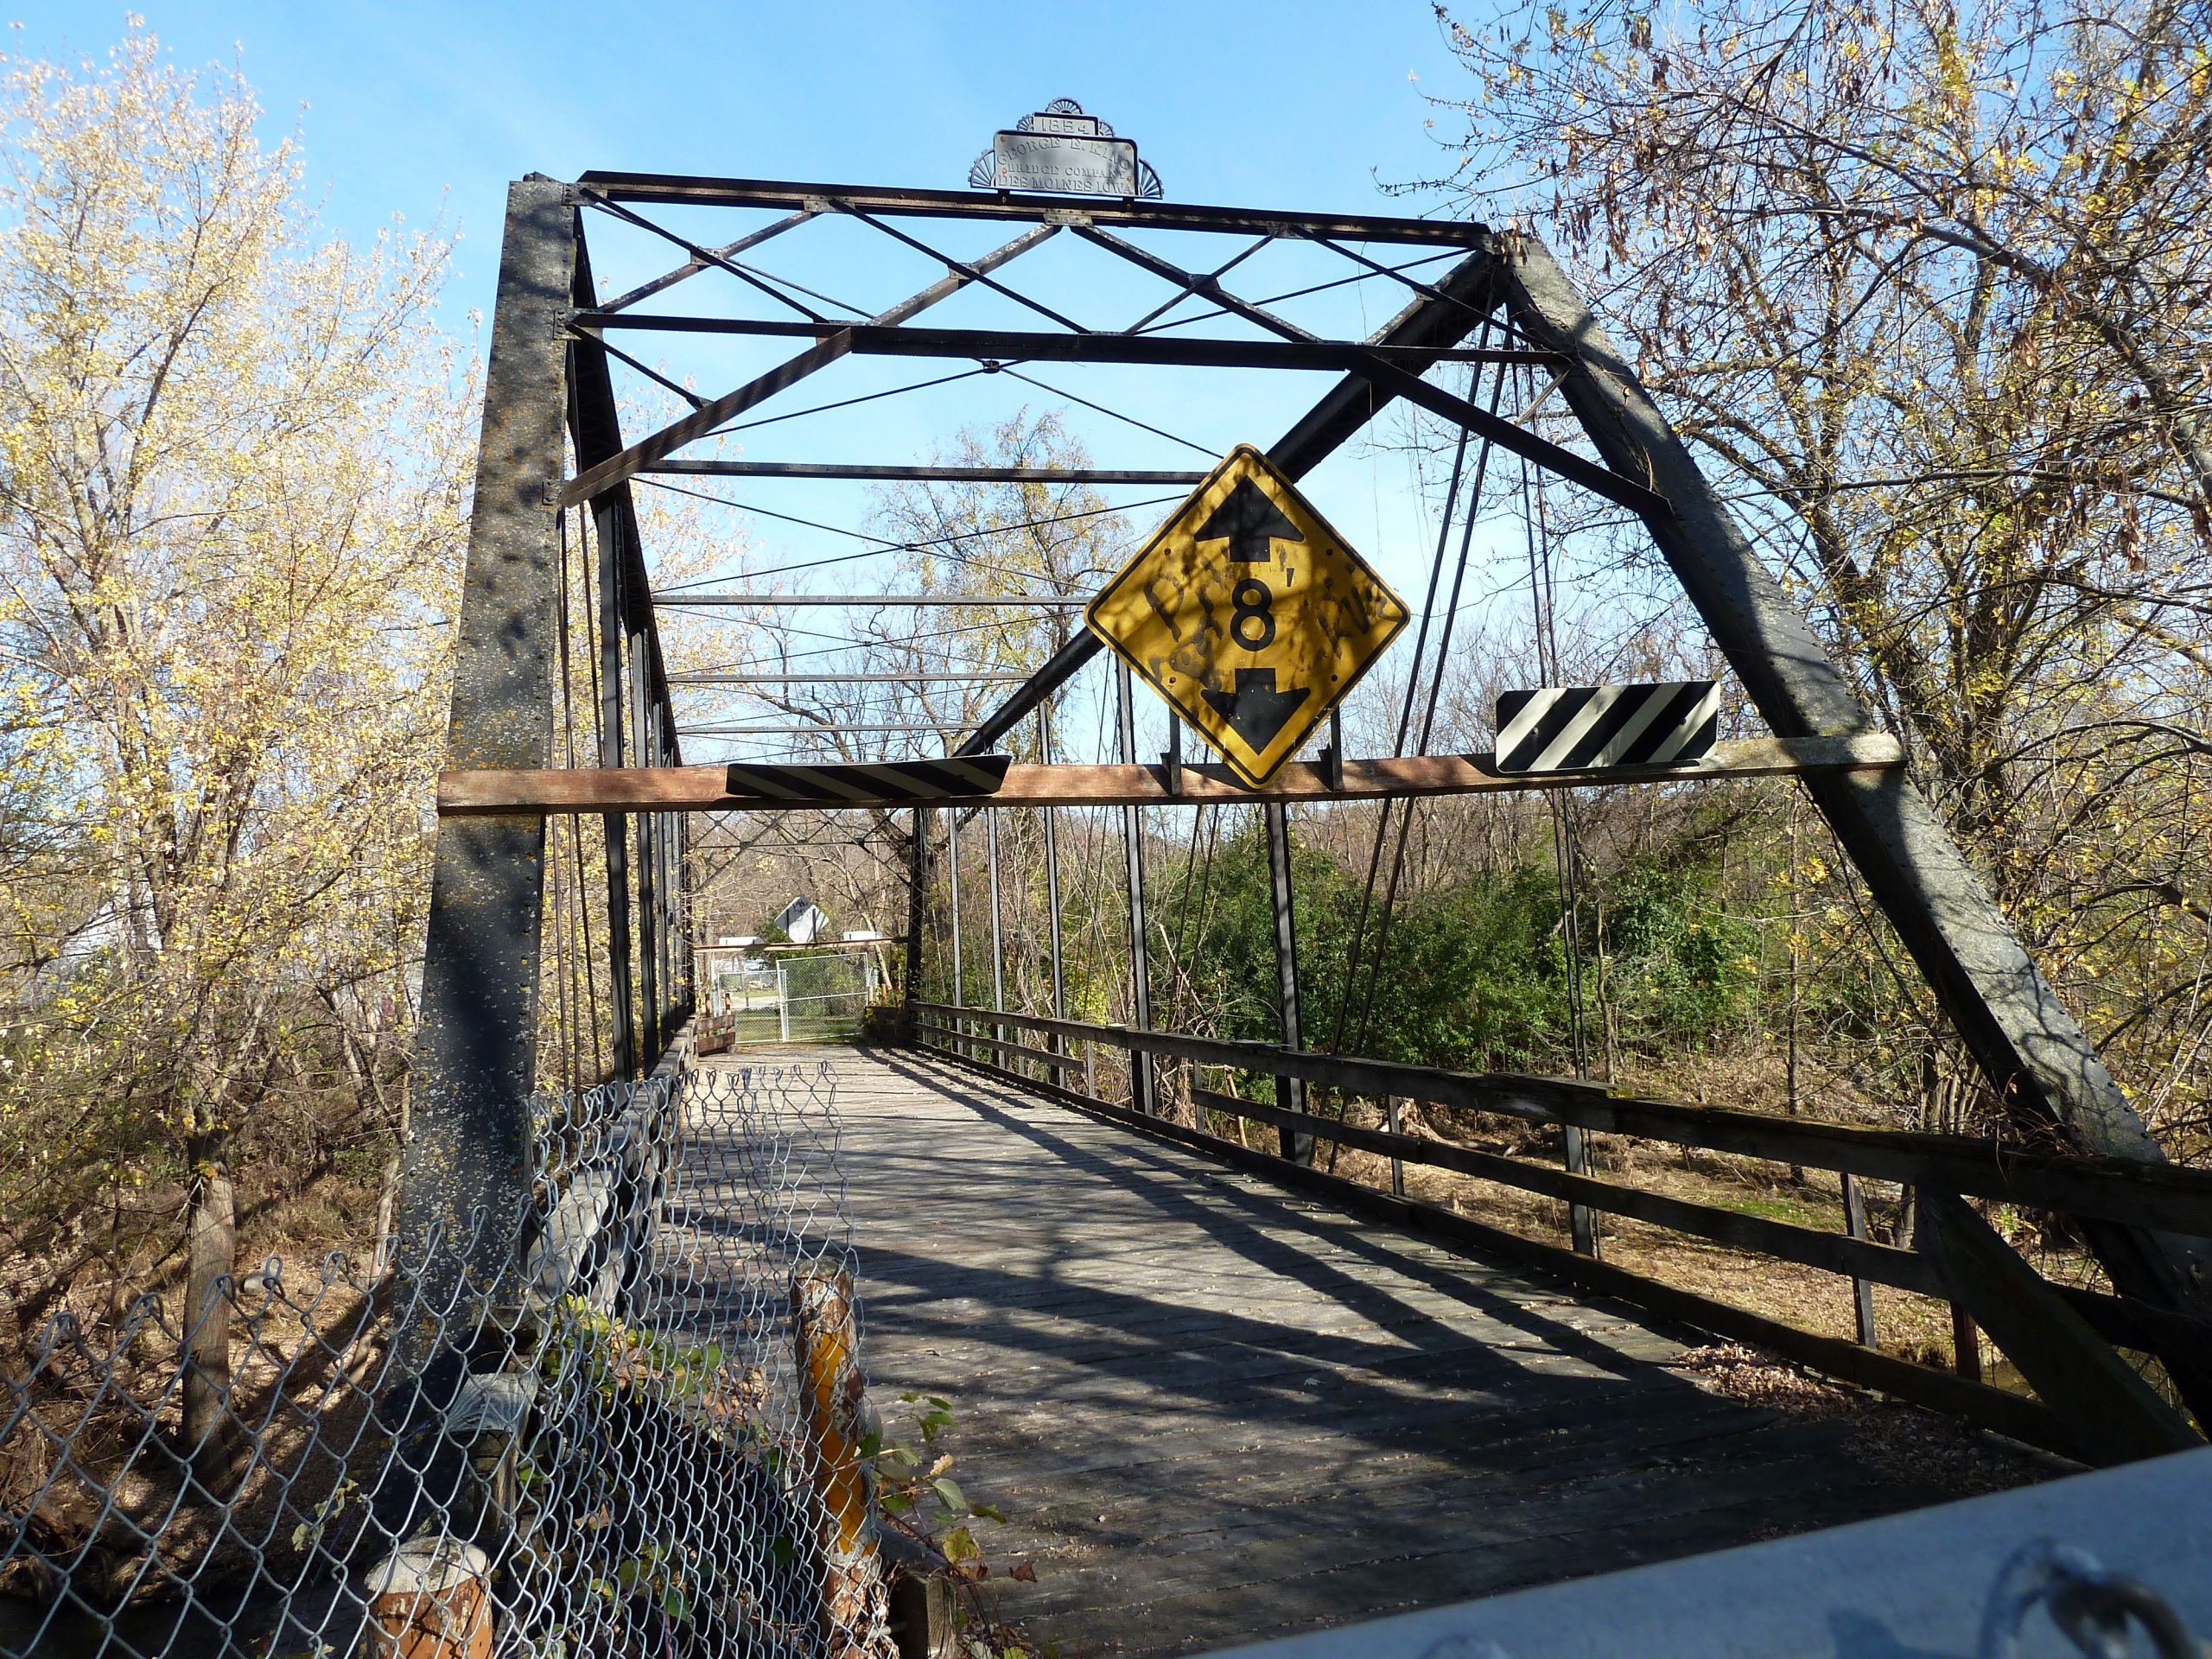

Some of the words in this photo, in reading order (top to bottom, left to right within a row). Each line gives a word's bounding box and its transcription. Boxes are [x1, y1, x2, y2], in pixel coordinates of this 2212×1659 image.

[996, 137, 1061, 165] GEORGE
[1070, 137, 1086, 151] E.
[1007, 163, 1059, 175] BRIDGE
[1065, 166, 1125, 180] COMPANY
[998, 175, 1028, 188] DES
[1032, 176, 1093, 192] MOINES
[1096, 181, 1135, 194] IOWA
